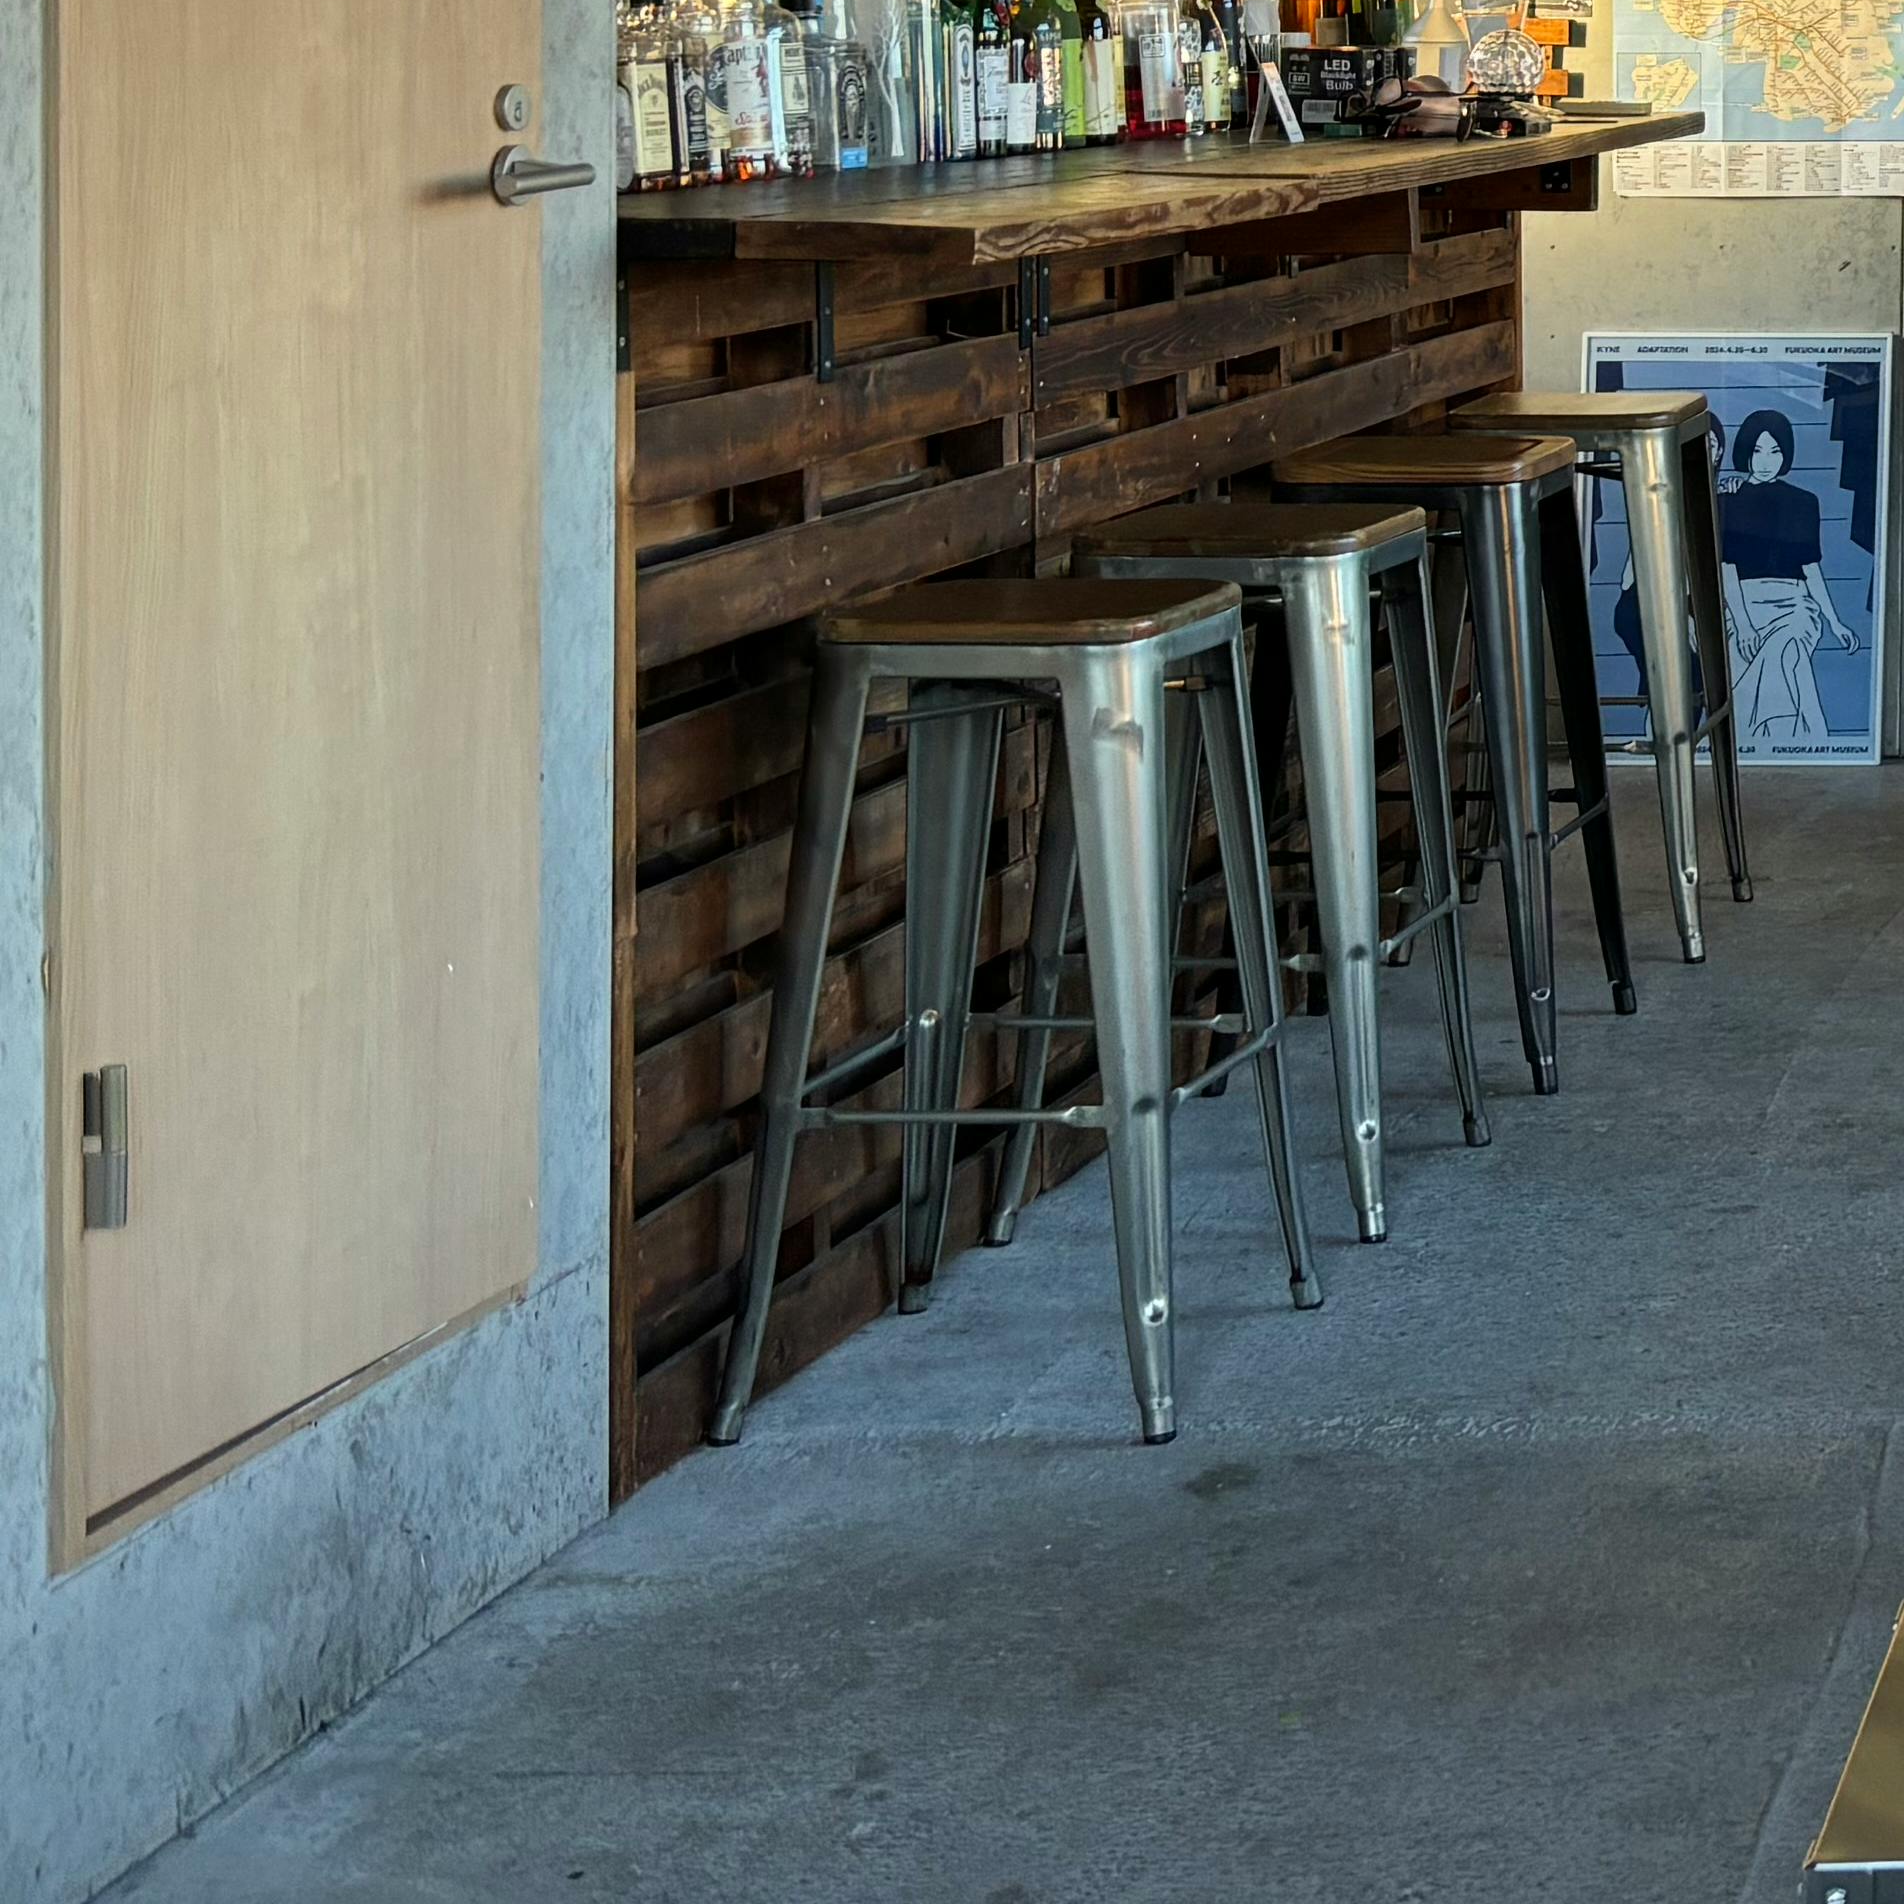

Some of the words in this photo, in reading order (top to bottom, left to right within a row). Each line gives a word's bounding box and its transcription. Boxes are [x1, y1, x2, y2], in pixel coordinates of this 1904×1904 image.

[1323, 59, 1351, 71] LED
[1325, 79, 1354, 91] Bulb
[1844, 345, 1882, 354] MUSEUM
